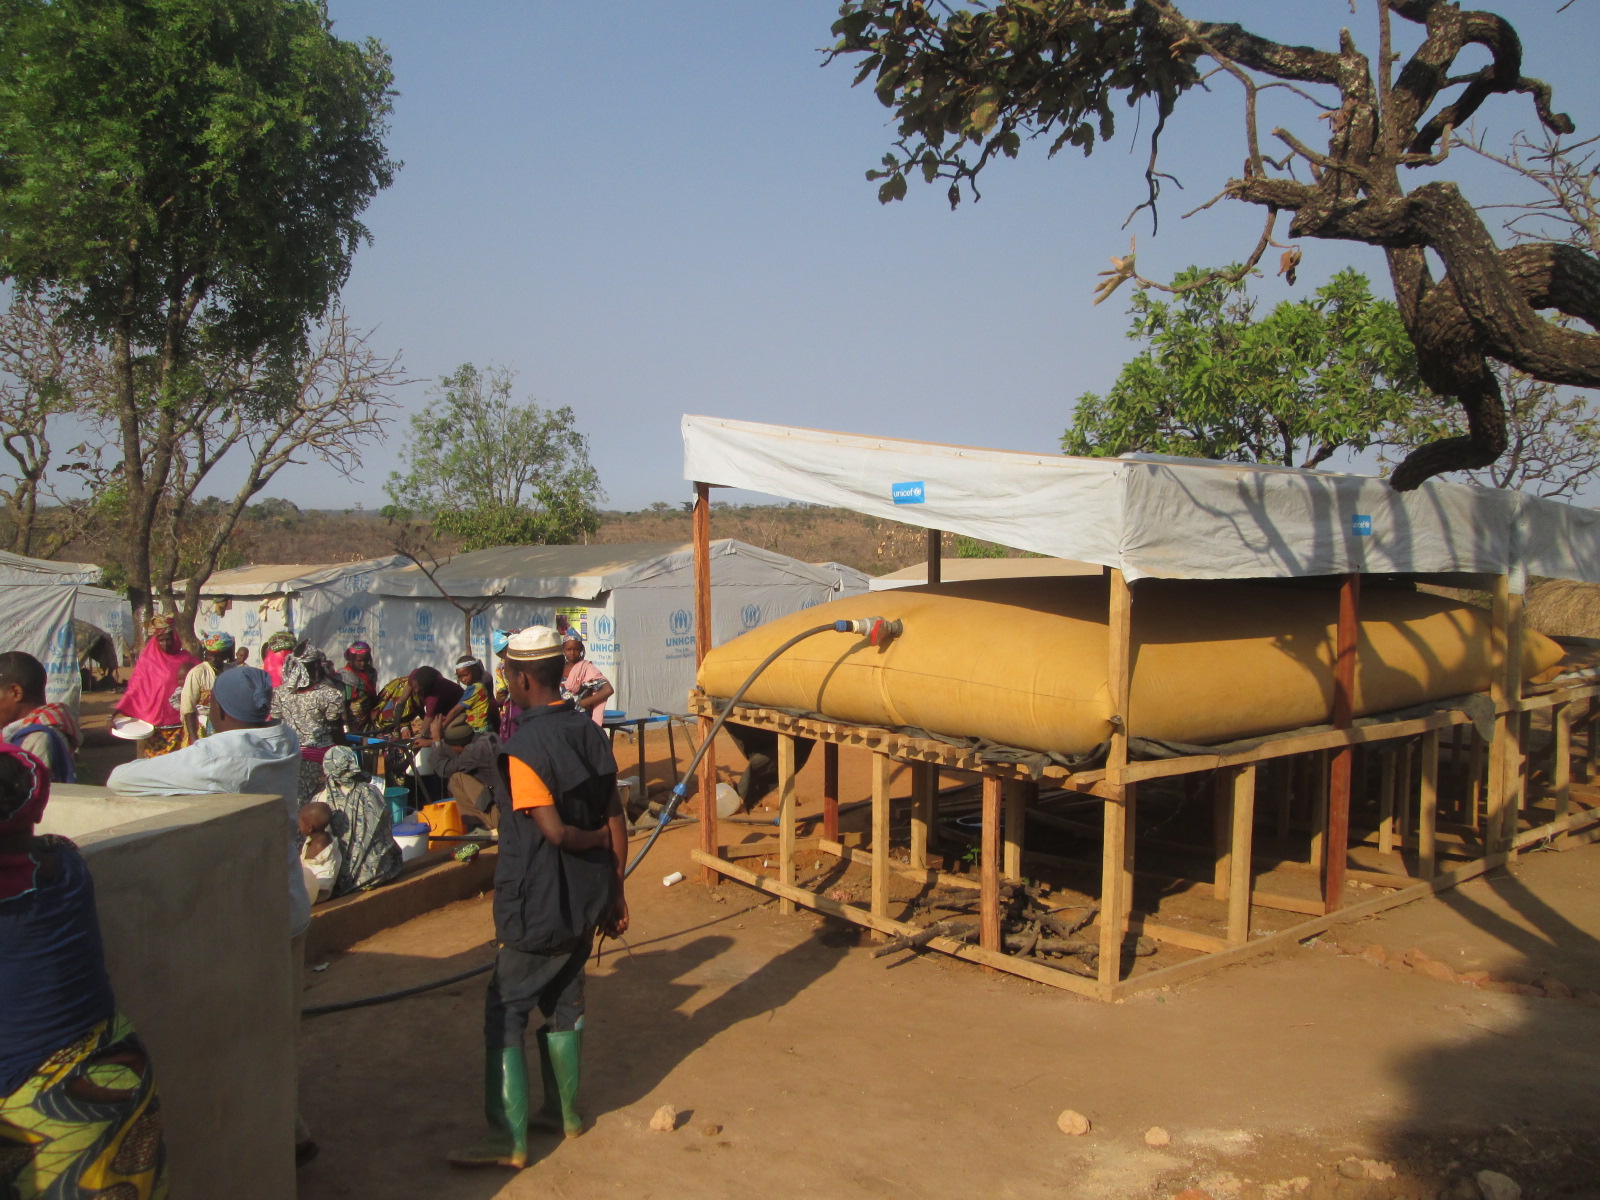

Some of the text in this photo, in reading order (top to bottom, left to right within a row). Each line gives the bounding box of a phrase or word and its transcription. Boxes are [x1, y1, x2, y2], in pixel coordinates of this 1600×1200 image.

[893, 488, 913, 497] unicef
[471, 638, 490, 646] NHCR
[665, 636, 696, 647] UNHCR
[590, 643, 621, 652] UNHCR
